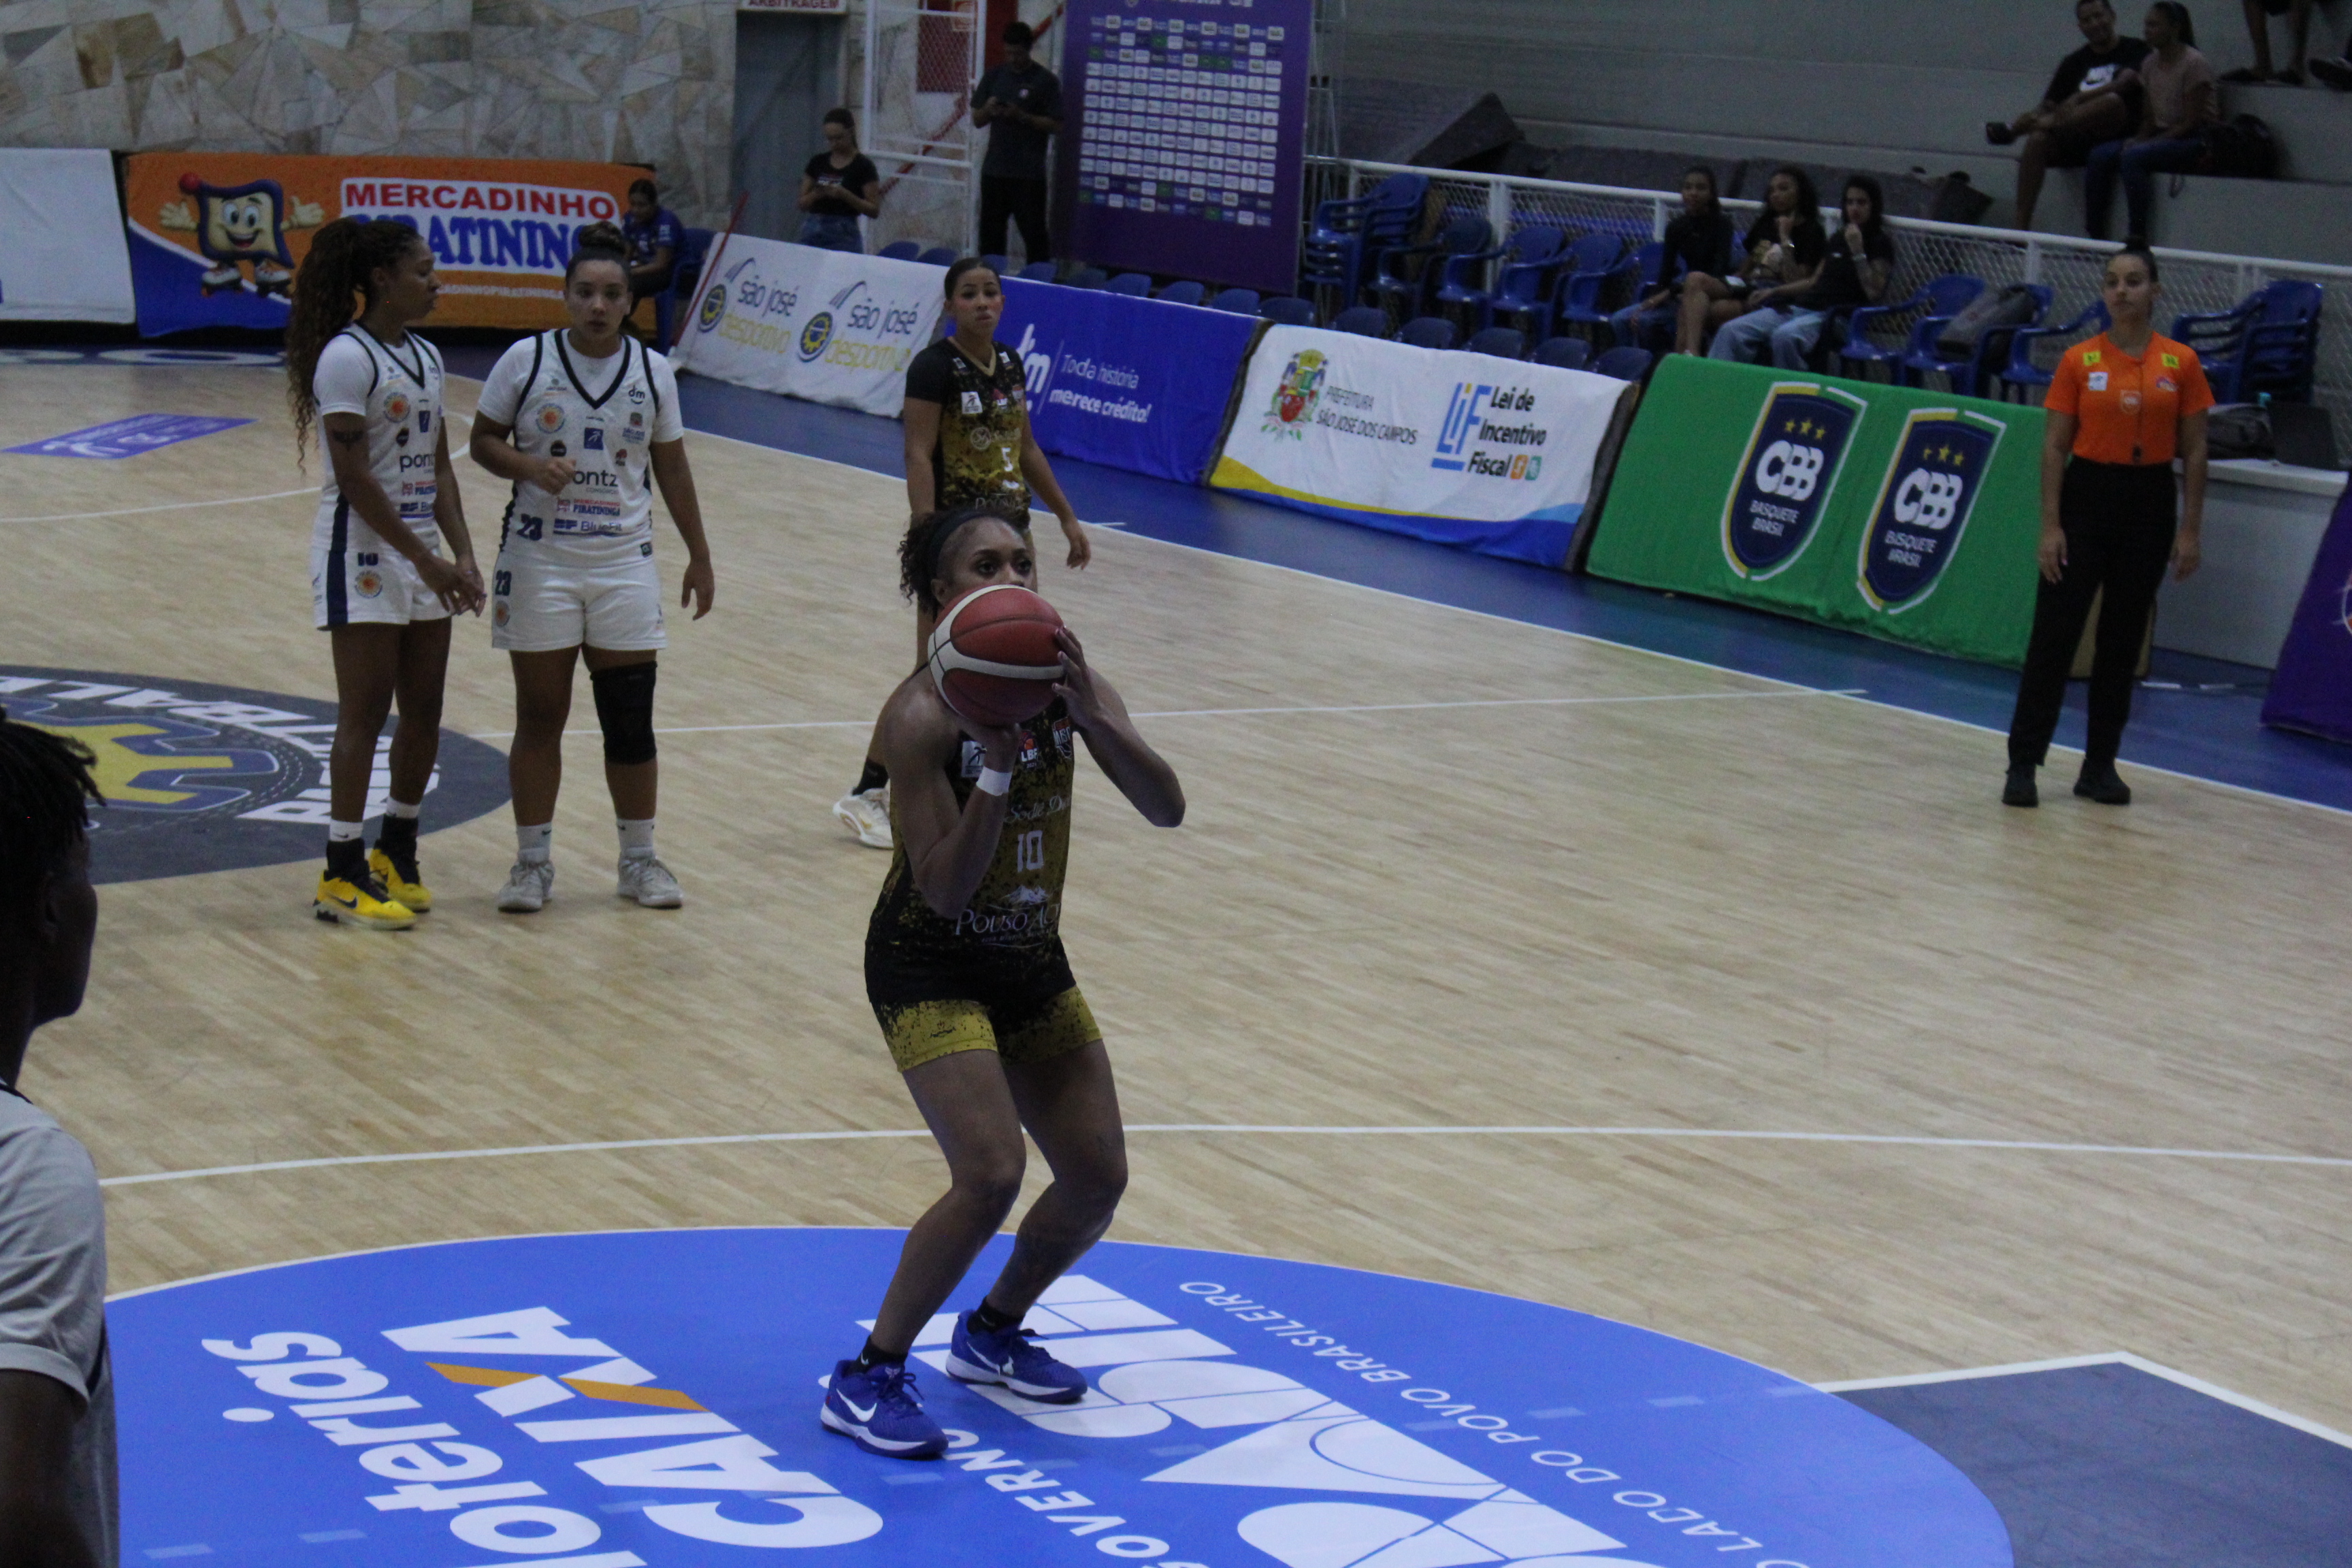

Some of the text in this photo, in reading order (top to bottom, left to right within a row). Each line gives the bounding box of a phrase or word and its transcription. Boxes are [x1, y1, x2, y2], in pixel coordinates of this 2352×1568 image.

[345, 183, 615, 220] MERCADINHO
[348, 214, 585, 269] ATININ
[738, 275, 800, 317] são josé
[847, 298, 919, 340] são josé
[1060, 354, 1096, 380] Toda
[628, 385, 646, 399] dm
[1326, 385, 1374, 412] PREFEITURA
[1490, 386, 1535, 412] Lei de
[1049, 389, 1153, 423] merece crédito!
[1356, 419, 1379, 438] DOS
[1377, 423, 1418, 445] CAMPOS
[1479, 419, 1547, 446] Incentivo
[1467, 451, 1513, 477] Fiscal
[1756, 440, 1825, 502] CBB
[572, 468, 619, 488] ontz
[1749, 499, 1801, 525] BASQUETE
[1894, 468, 1963, 530] CBB
[517, 513, 544, 542] 23
[1751, 516, 1785, 537] BRASIL
[1884, 529, 1938, 554] BASQUETE
[1887, 548, 1923, 568] BRASIL
[495, 570, 512, 596] 23
[1021, 747, 1038, 763] LBF
[1017, 830, 1044, 872] 10
[955, 909, 1028, 936] POUSO
[381, 1307, 883, 1548] CAIXA
[855, 1274, 1703, 1568] RASIL
[1179, 1282, 1763, 1552] LADO DO POVO BRASILEIRO
[943, 1428, 1209, 1568] OVERNO
